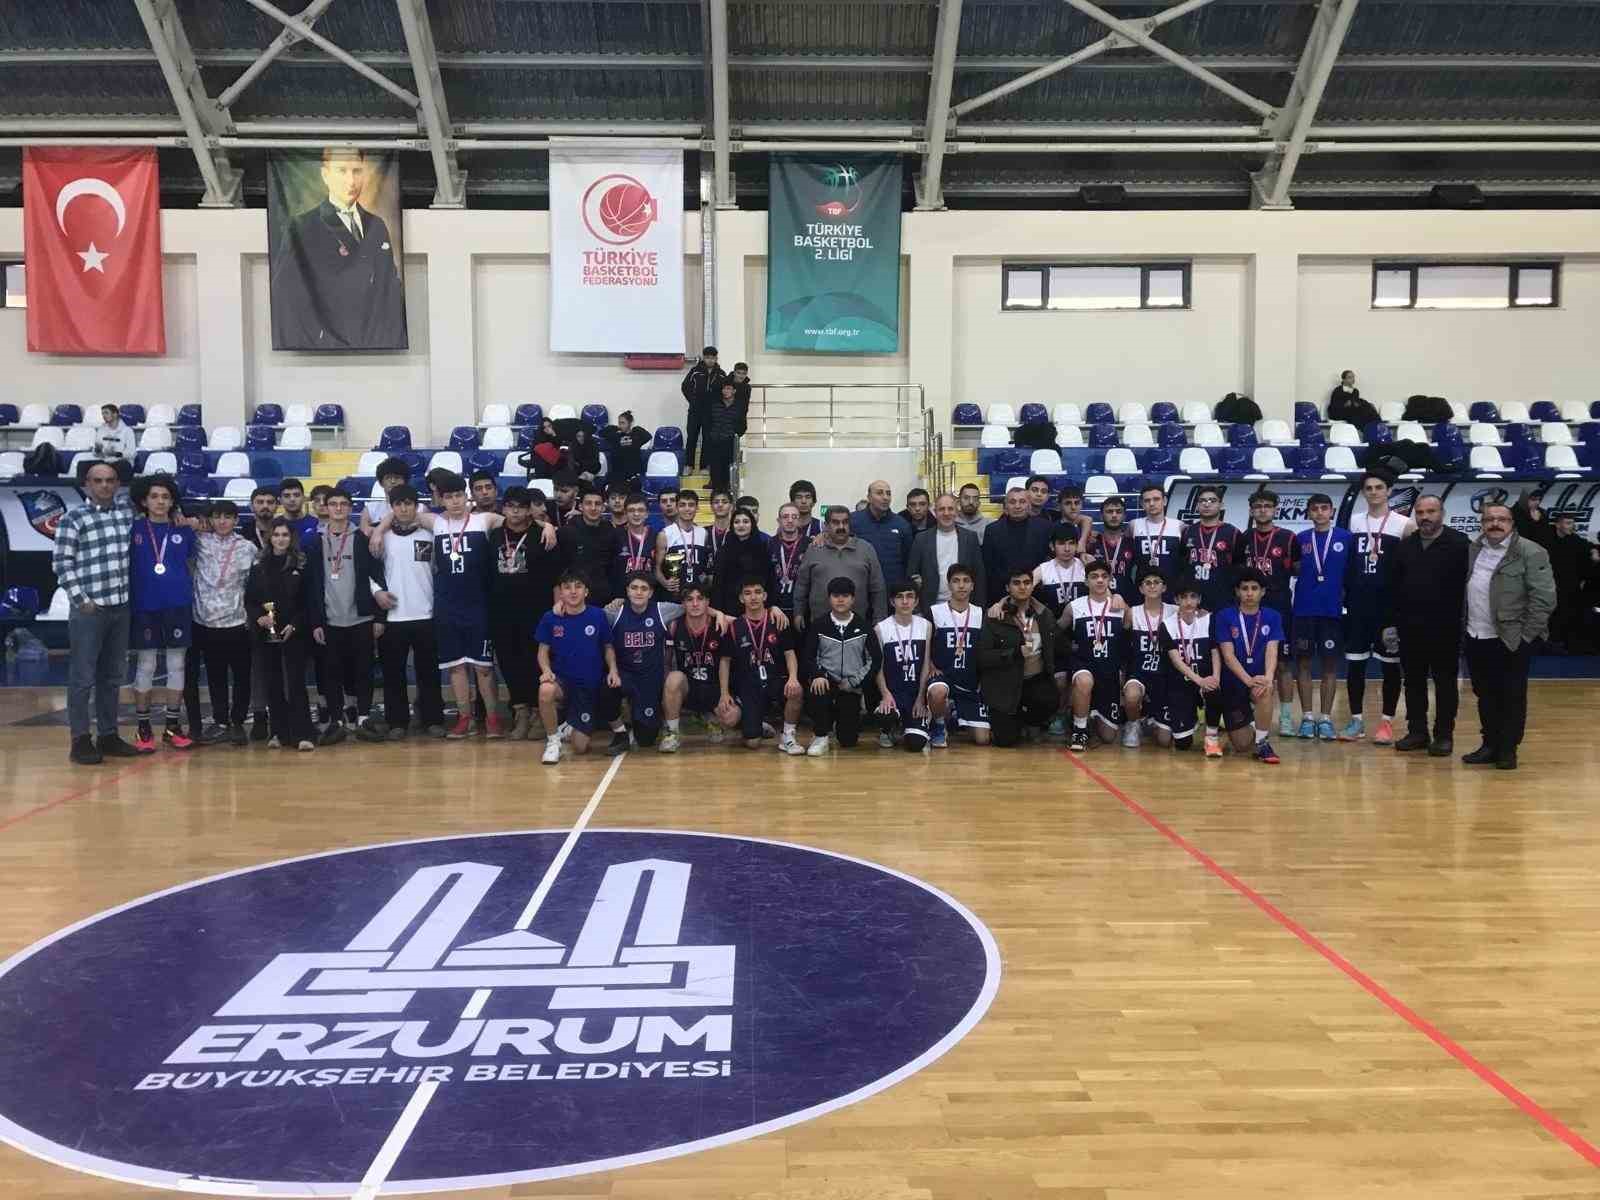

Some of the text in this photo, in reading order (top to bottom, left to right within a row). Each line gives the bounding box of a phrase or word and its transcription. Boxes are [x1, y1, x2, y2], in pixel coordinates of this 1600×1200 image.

[806, 221, 863, 236] TÜRKİYE
[794, 235, 874, 249] BASKETBOL
[583, 247, 658, 265] TÜRKİYE
[583, 265, 658, 277] BASKETBOL
[583, 276, 658, 286] FEDERASYONU
[804, 327, 861, 337] www.tbf.org.tr
[162, 1014, 733, 1065] ERZURUM
[133, 1060, 732, 1091] BÜYÜKŞEHİR BELEDİYESİ
